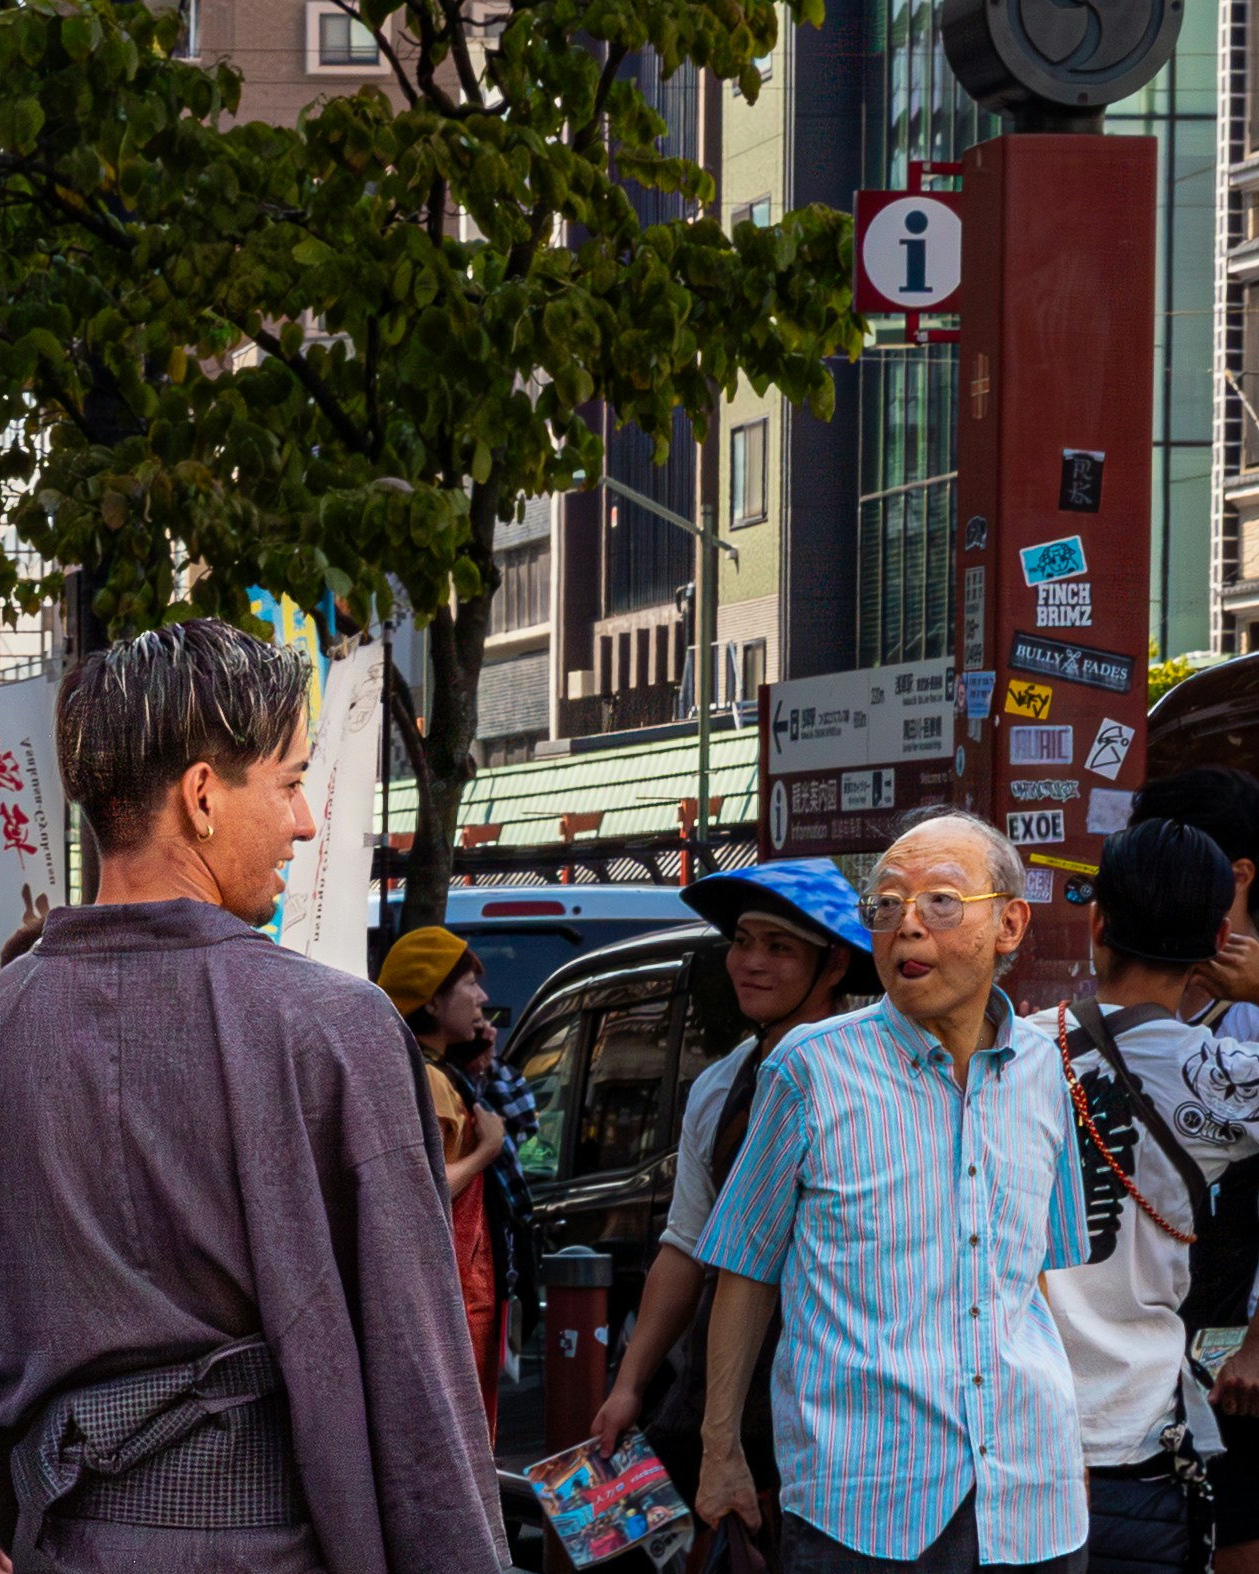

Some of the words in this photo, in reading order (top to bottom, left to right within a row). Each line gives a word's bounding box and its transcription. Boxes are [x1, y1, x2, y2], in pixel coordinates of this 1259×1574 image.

[1037, 583, 1091, 605] FINCH
[1036, 606, 1092, 627] BRIMZ
[1016, 644, 1064, 666] BULLY
[1082, 659, 1128, 680] FADES
[1009, 813, 1062, 841] EXOE
